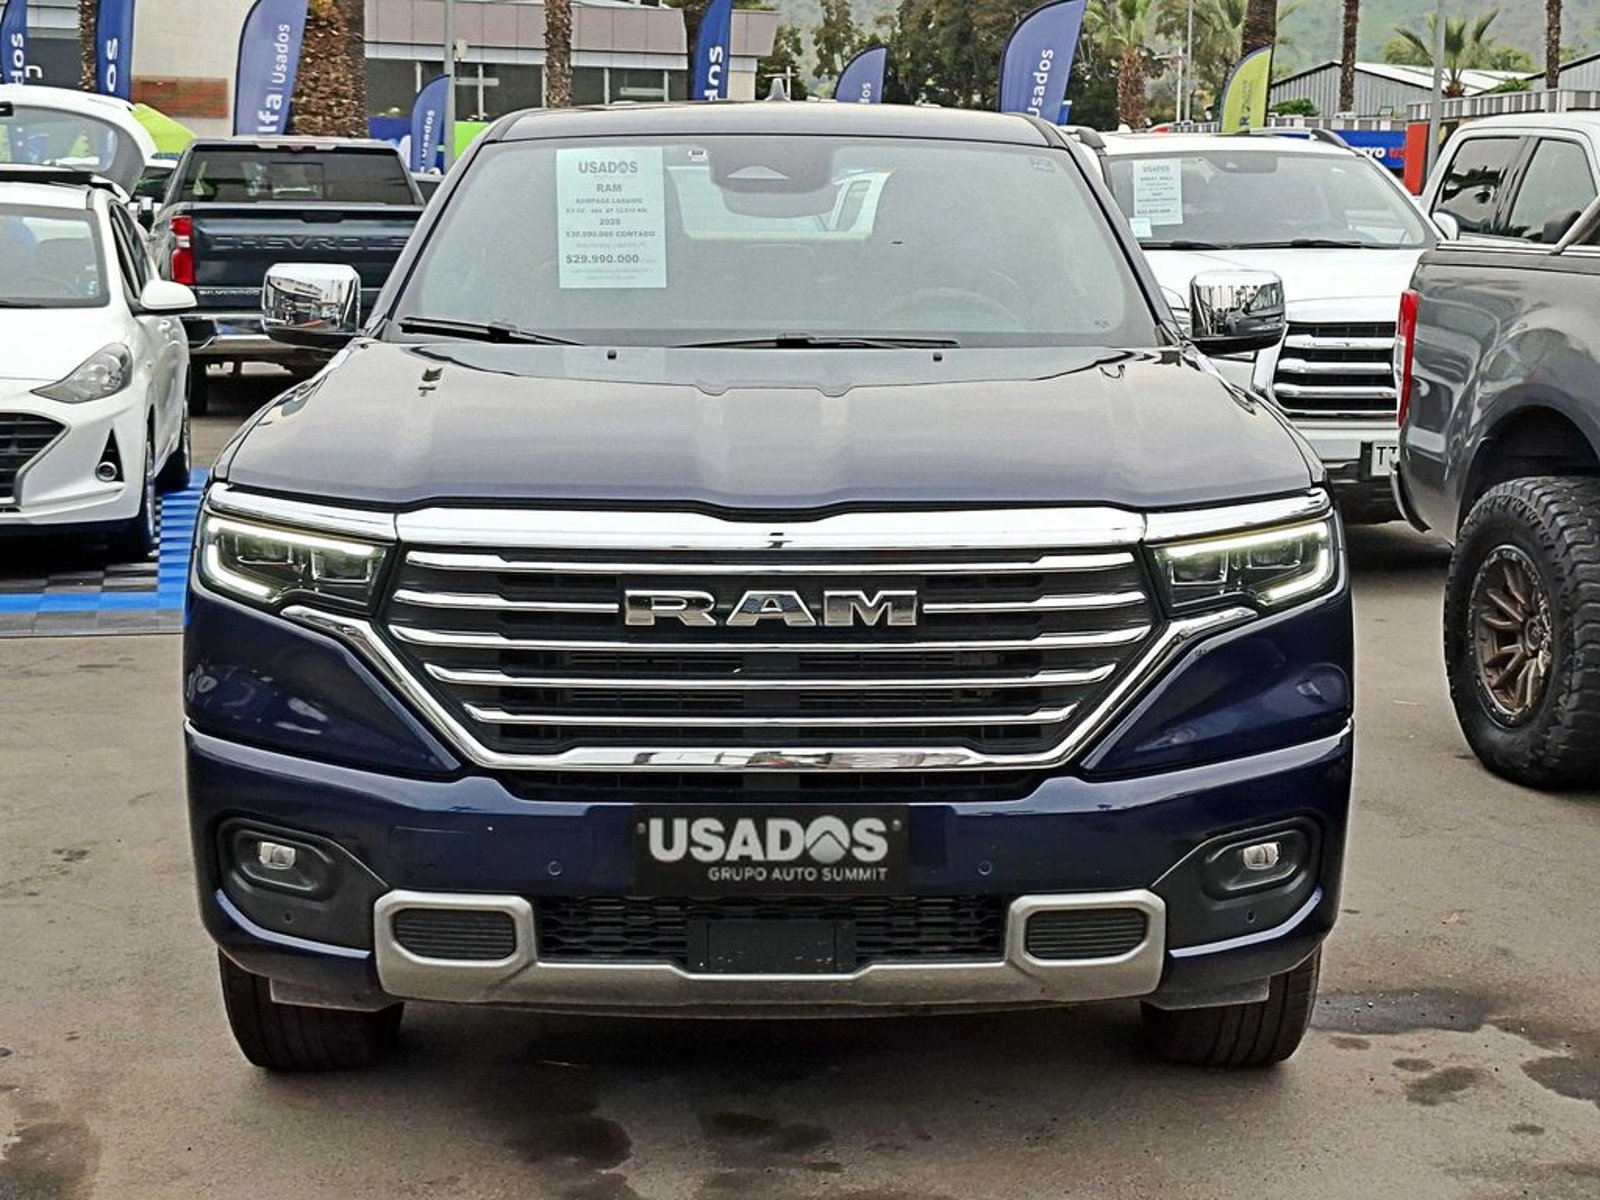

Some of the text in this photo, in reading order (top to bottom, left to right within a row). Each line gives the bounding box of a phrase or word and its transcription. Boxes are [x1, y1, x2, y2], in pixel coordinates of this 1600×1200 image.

[271, 24, 291, 84] Usados
[578, 161, 639, 174] USADOS
[596, 184, 622, 193] RAM
[566, 254, 640, 264] $29.990.000
[624, 589, 918, 627] RAM
[649, 815, 889, 864] USADOS
[708, 867, 889, 882] GRUPO AUTO SUMMIT
